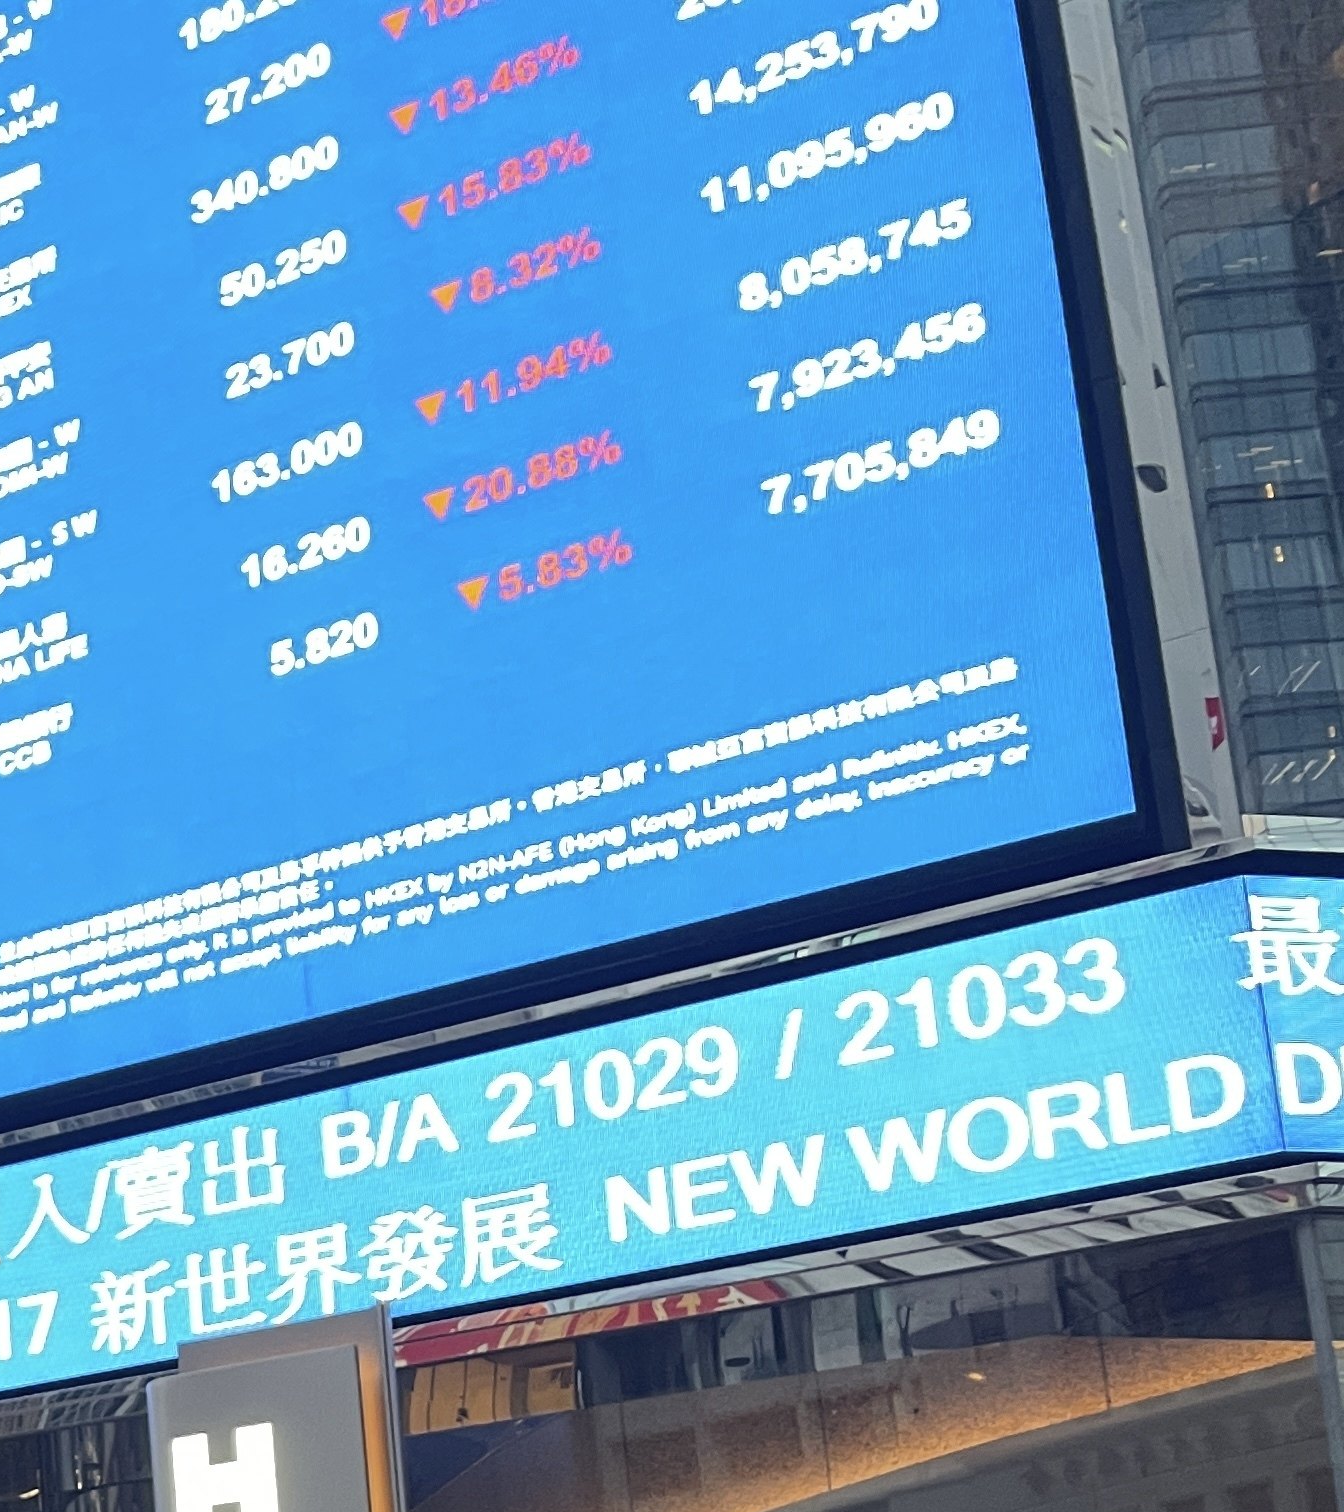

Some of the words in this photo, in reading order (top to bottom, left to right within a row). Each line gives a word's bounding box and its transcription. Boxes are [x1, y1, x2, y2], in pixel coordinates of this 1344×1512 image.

[205, 43, 332, 125] 27.200
[429, 36, 581, 121] 13.46%
[689, 0, 939, 115] 14,253,790
[191, 136, 339, 223] 340.800
[439, 133, 592, 217] 15.83%
[700, 91, 955, 213] 11,095,960
[220, 230, 347, 307] 50.250
[469, 226, 602, 303] 8.32%
[738, 197, 972, 311] 8,058,745
[16, 368, 55, 401] AN
[225, 322, 355, 399] 23.700
[457, 331, 614, 413] 11.94%
[748, 302, 987, 412] 7,923,456
[211, 422, 363, 503] 163.000
[463, 430, 623, 513] 20.88%
[760, 408, 1000, 515] 7,705,849
[240, 517, 371, 588] 16.260
[498, 530, 633, 601] 5.83%
[35, 634, 89, 672] LIFE
[270, 612, 379, 677] 5.820
[321, 1093, 460, 1179] B/A
[485, 1025, 739, 1143] 21029
[835, 938, 1126, 1067] 21033
[90, 1183, 564, 1355] 新世界發展
[605, 1134, 825, 1243] NEW
[846, 1054, 1246, 1192] WORLD
